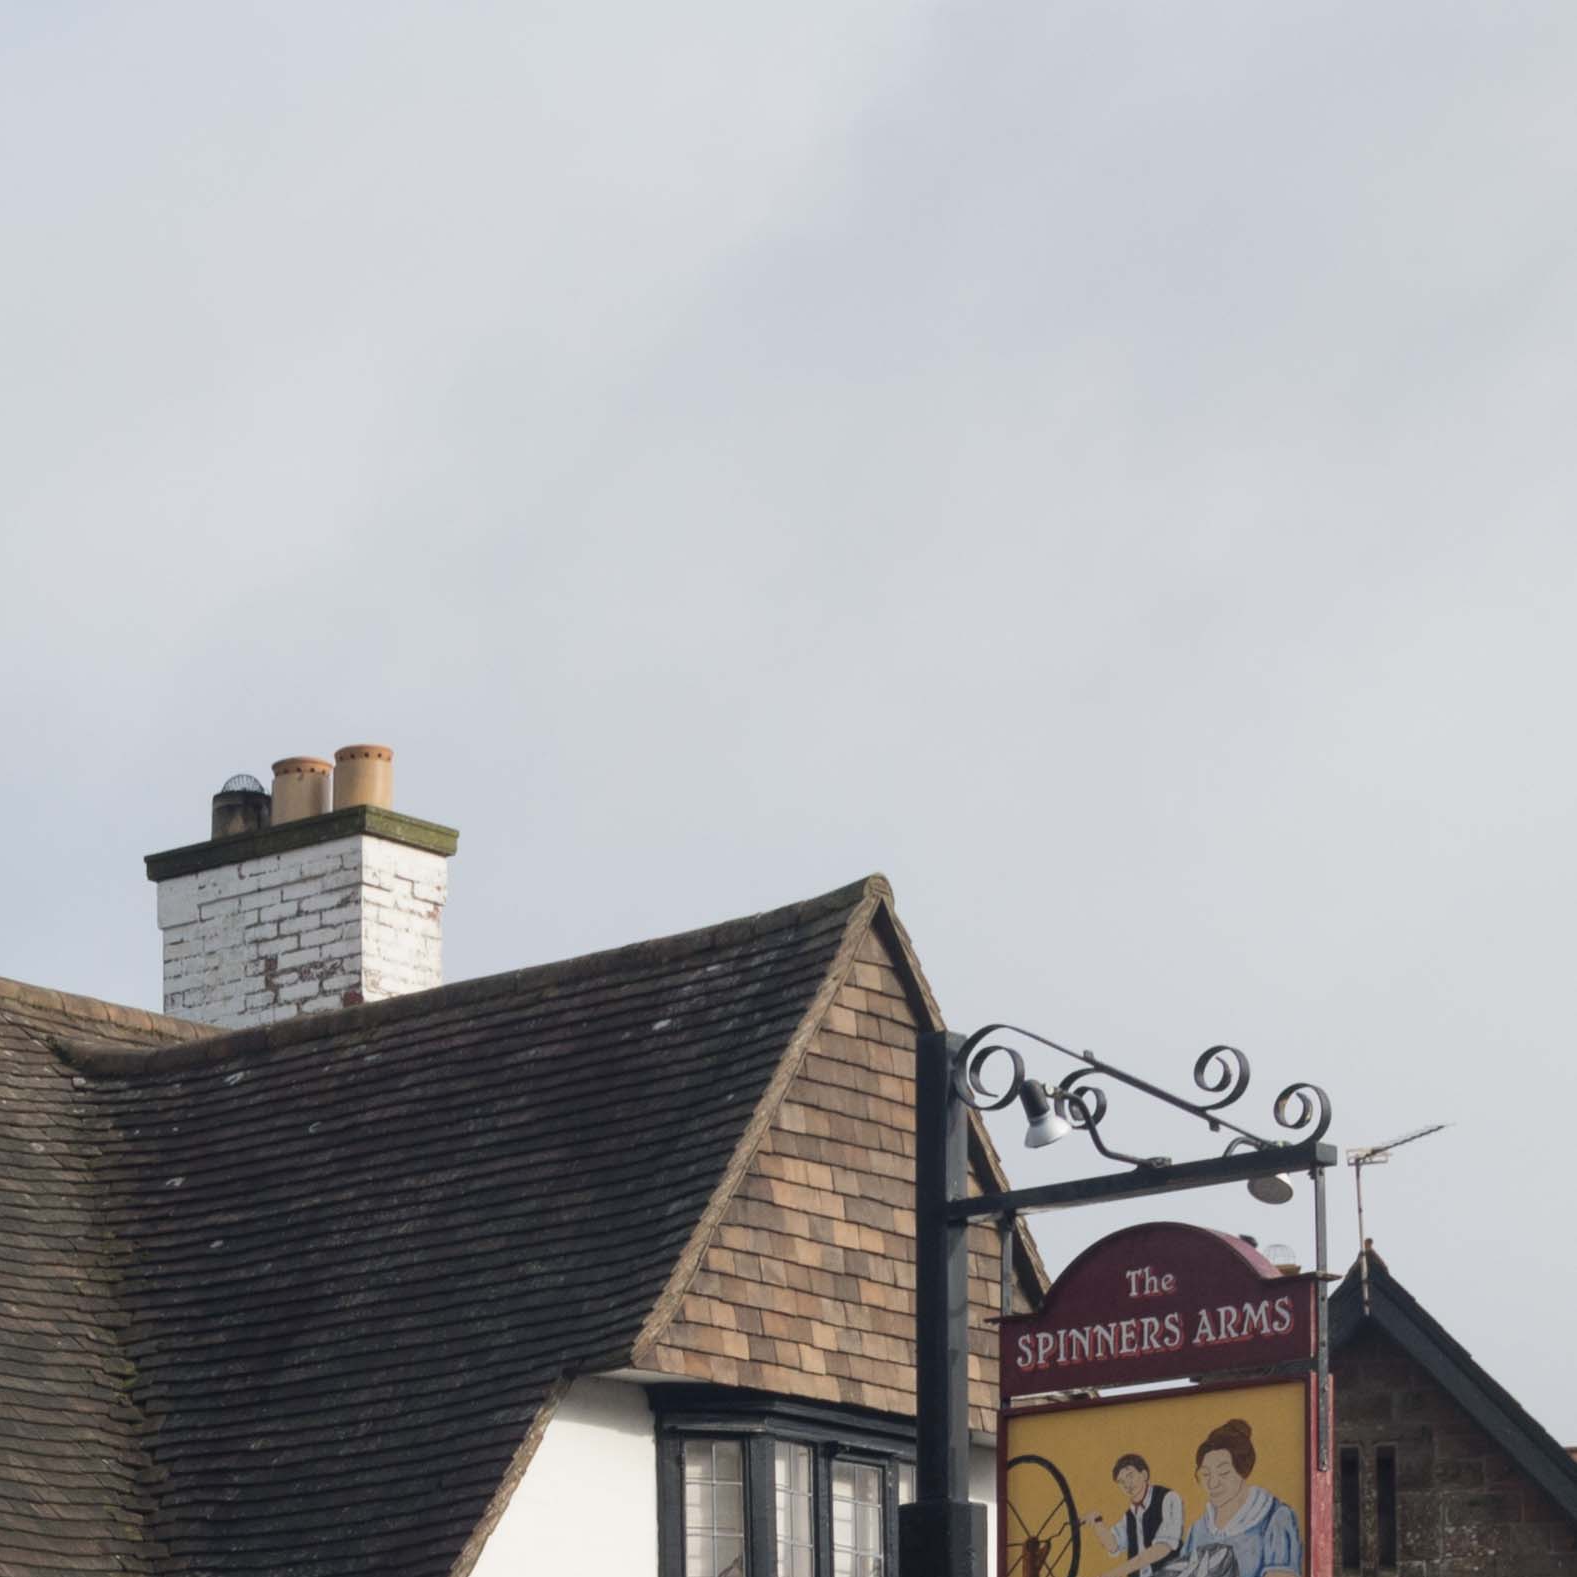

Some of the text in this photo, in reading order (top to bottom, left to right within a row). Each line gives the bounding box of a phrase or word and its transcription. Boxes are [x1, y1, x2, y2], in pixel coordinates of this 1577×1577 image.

[1126, 1266, 1175, 1297] The
[1016, 1296, 1293, 1368] SPINNERS ARMS
